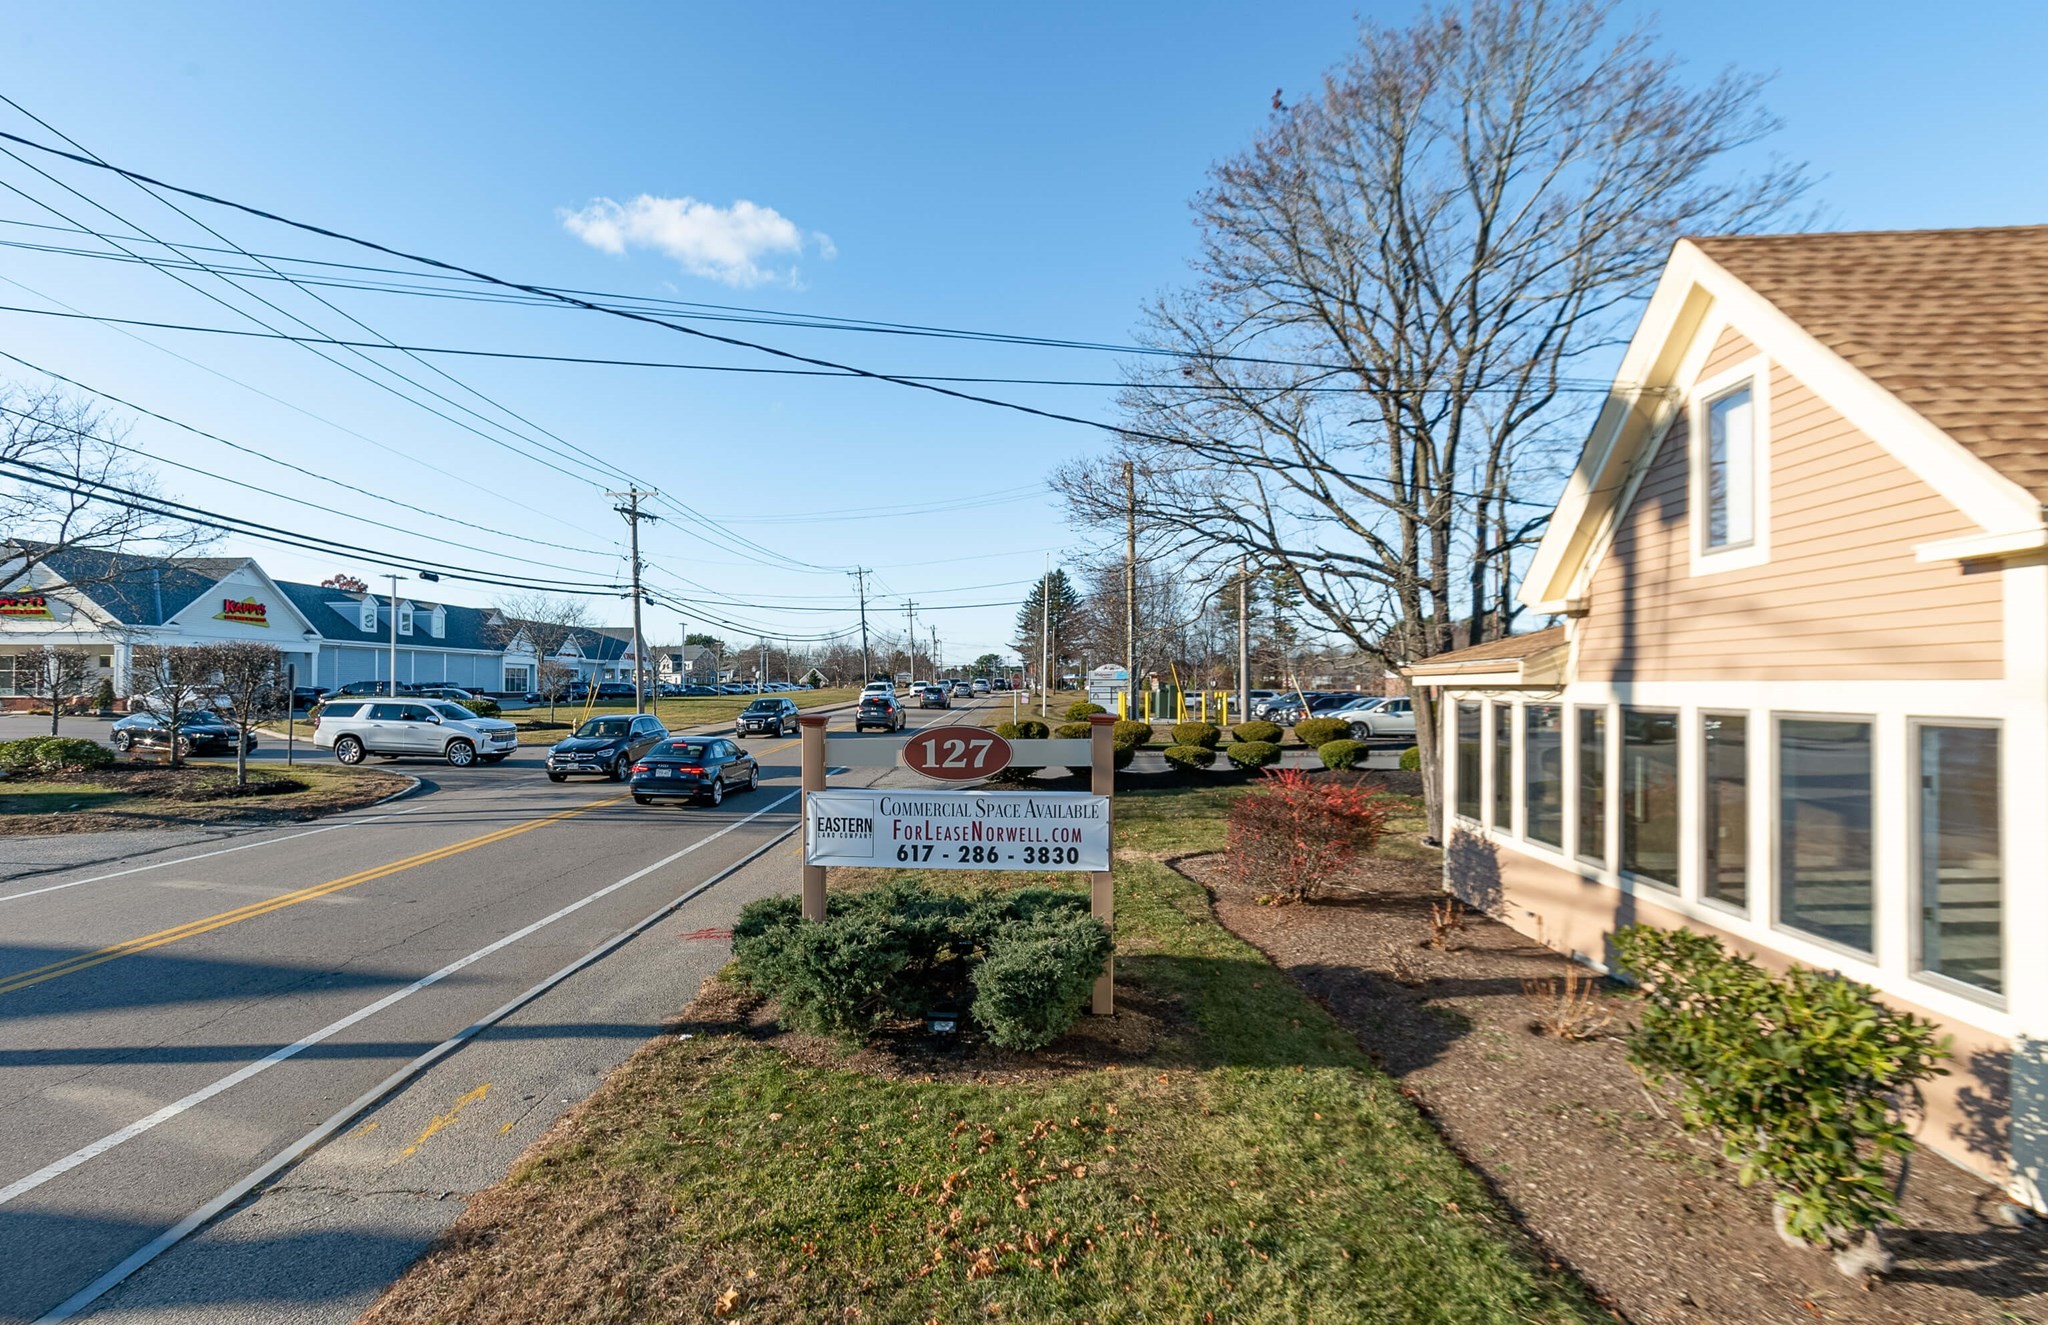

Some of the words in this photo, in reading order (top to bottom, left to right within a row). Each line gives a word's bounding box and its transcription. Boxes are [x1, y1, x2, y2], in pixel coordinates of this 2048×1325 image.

[920, 738, 995, 769] 127
[879, 796, 972, 818] COMMERCIAL
[975, 798, 1021, 819] SPACE
[1024, 799, 1100, 819] AVAILABLE
[817, 816, 873, 833] EASTERN
[839, 832, 873, 840] COMPANY
[896, 844, 935, 862] 617
[957, 845, 999, 863] 286
[1022, 846, 1080, 864] 3830
